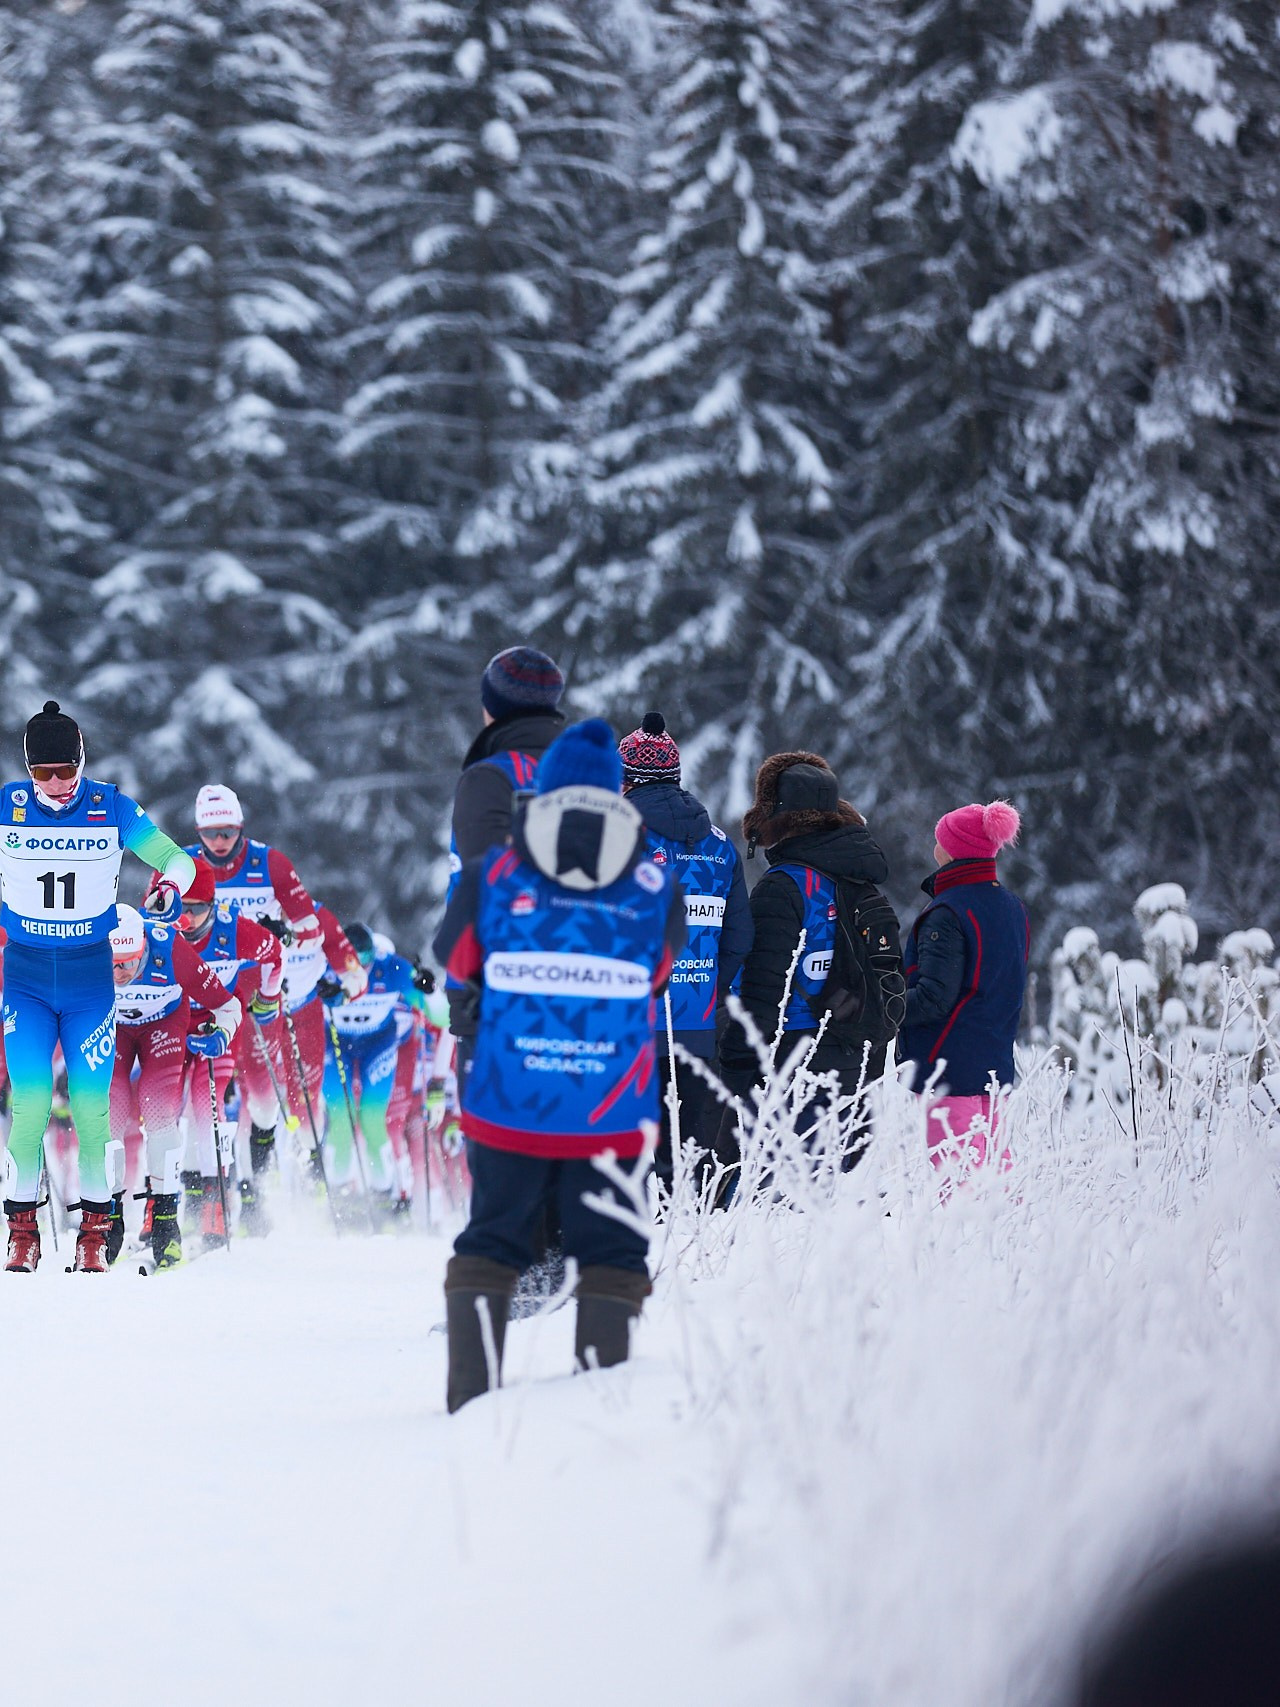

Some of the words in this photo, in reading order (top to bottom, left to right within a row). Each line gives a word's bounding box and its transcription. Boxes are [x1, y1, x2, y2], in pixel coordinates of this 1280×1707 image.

[25, 837, 109, 851] ФОСАГРО
[675, 853, 714, 862] Кировский
[36, 871, 76, 910] 11
[214, 896, 267, 907] ОСАГРО
[21, 919, 93, 939] ЧЕПЕЦКОЕ
[110, 937, 134, 945] ОЙЛ
[672, 958, 714, 969] РОВСКАЯ
[494, 963, 612, 984] ПЕРСОНАЛ
[670, 972, 710, 983] БЛАСТЬ
[114, 990, 172, 1001] ОСАГРО
[523, 1054, 606, 1074] ОБЛАСТЬ
